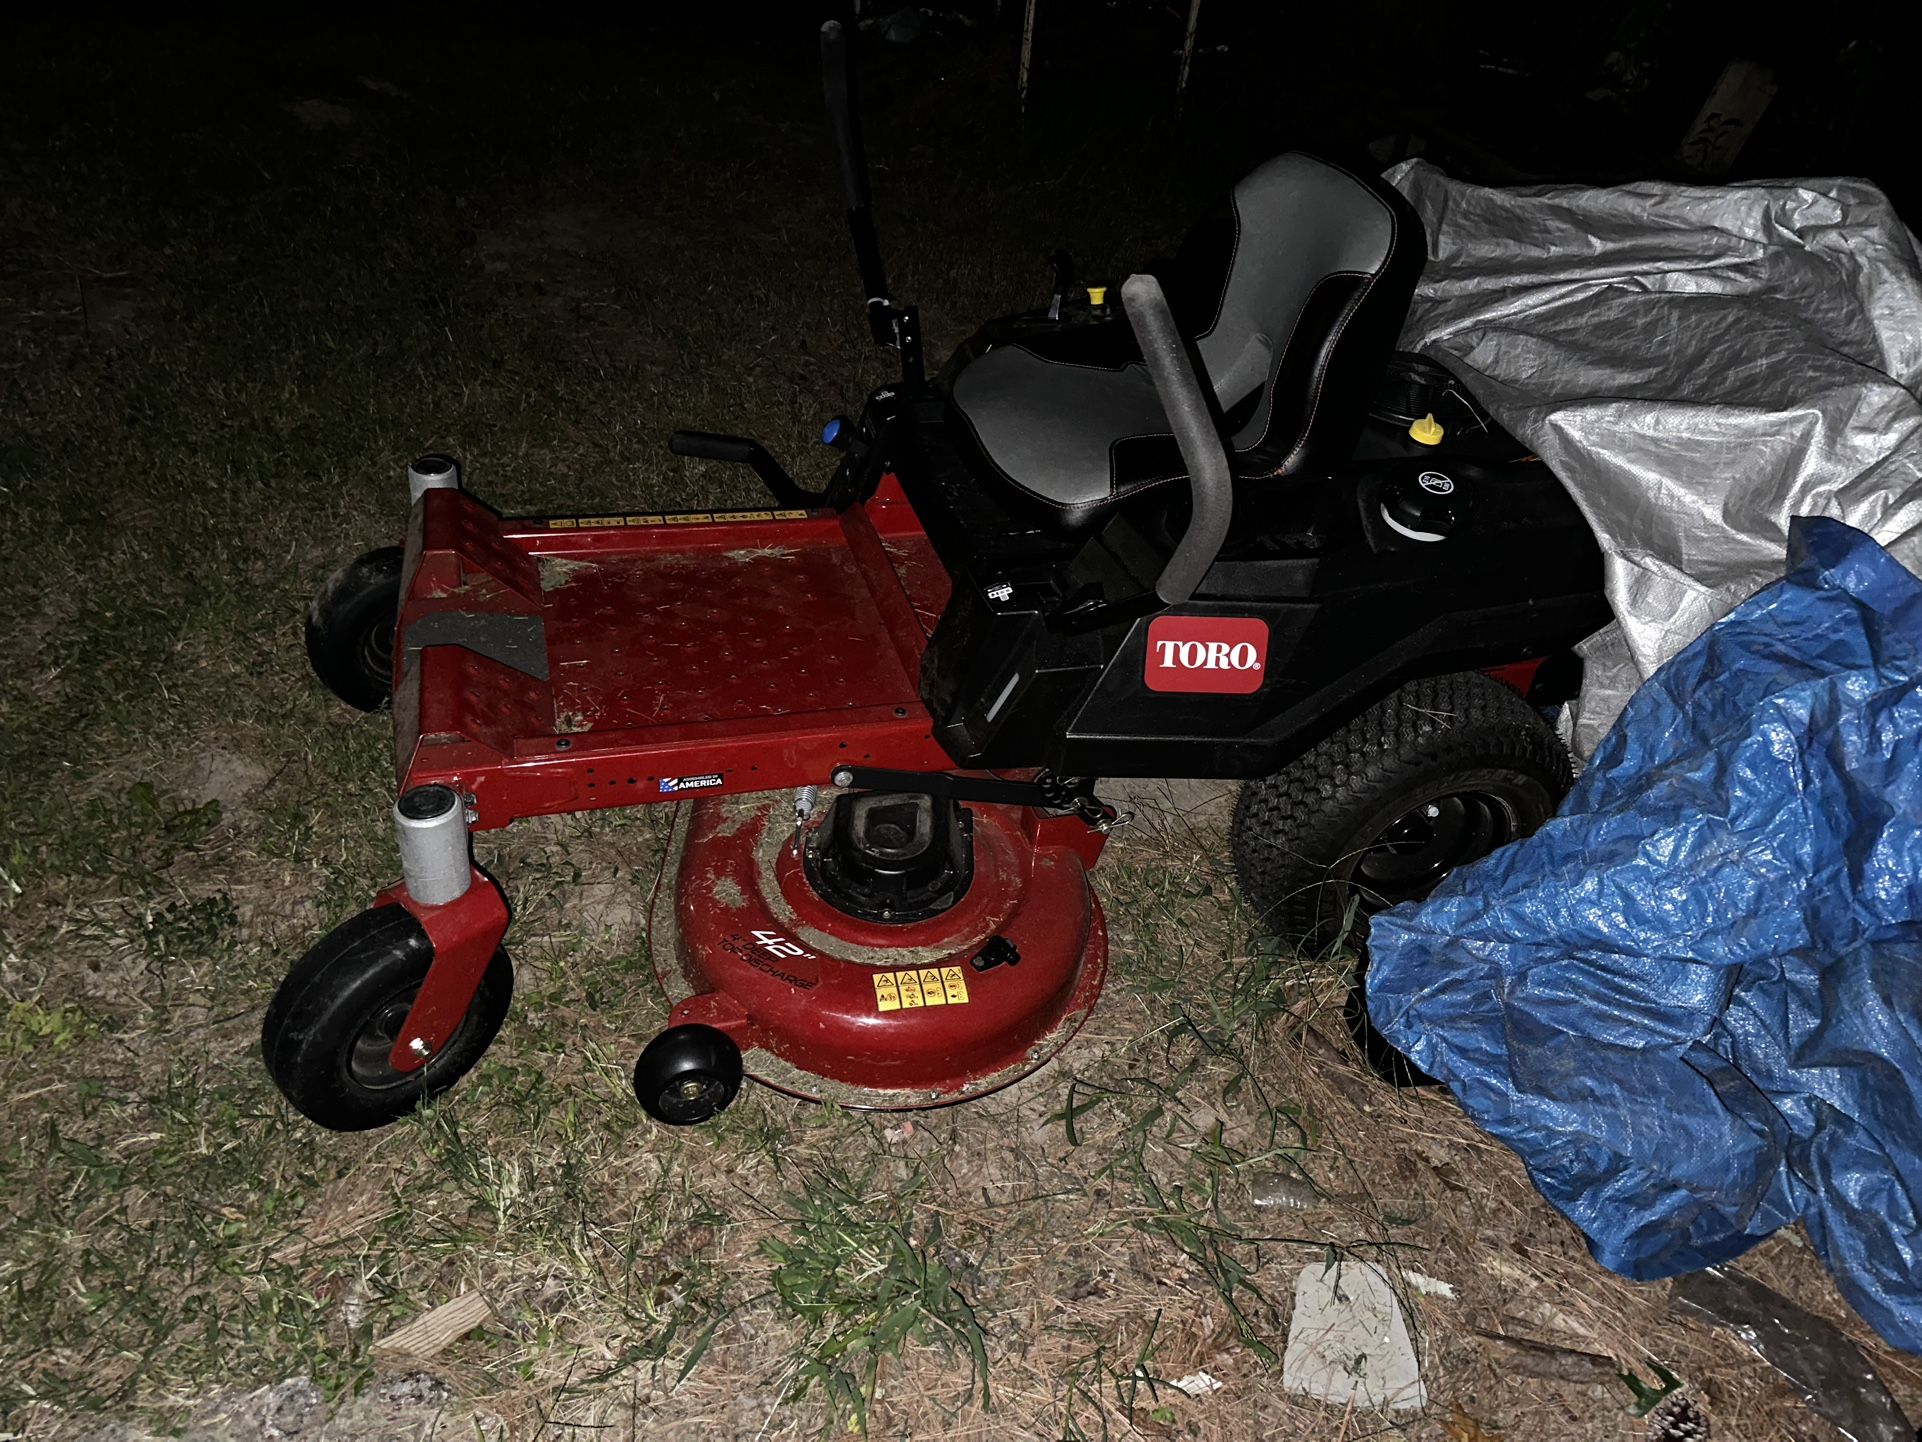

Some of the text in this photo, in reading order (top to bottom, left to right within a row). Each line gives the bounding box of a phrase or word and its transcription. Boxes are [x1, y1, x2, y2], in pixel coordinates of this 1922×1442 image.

[1156, 640, 1258, 670] TORO
[678, 778, 722, 789] AMERICA
[717, 938, 816, 990] TOP DISCHARGE
